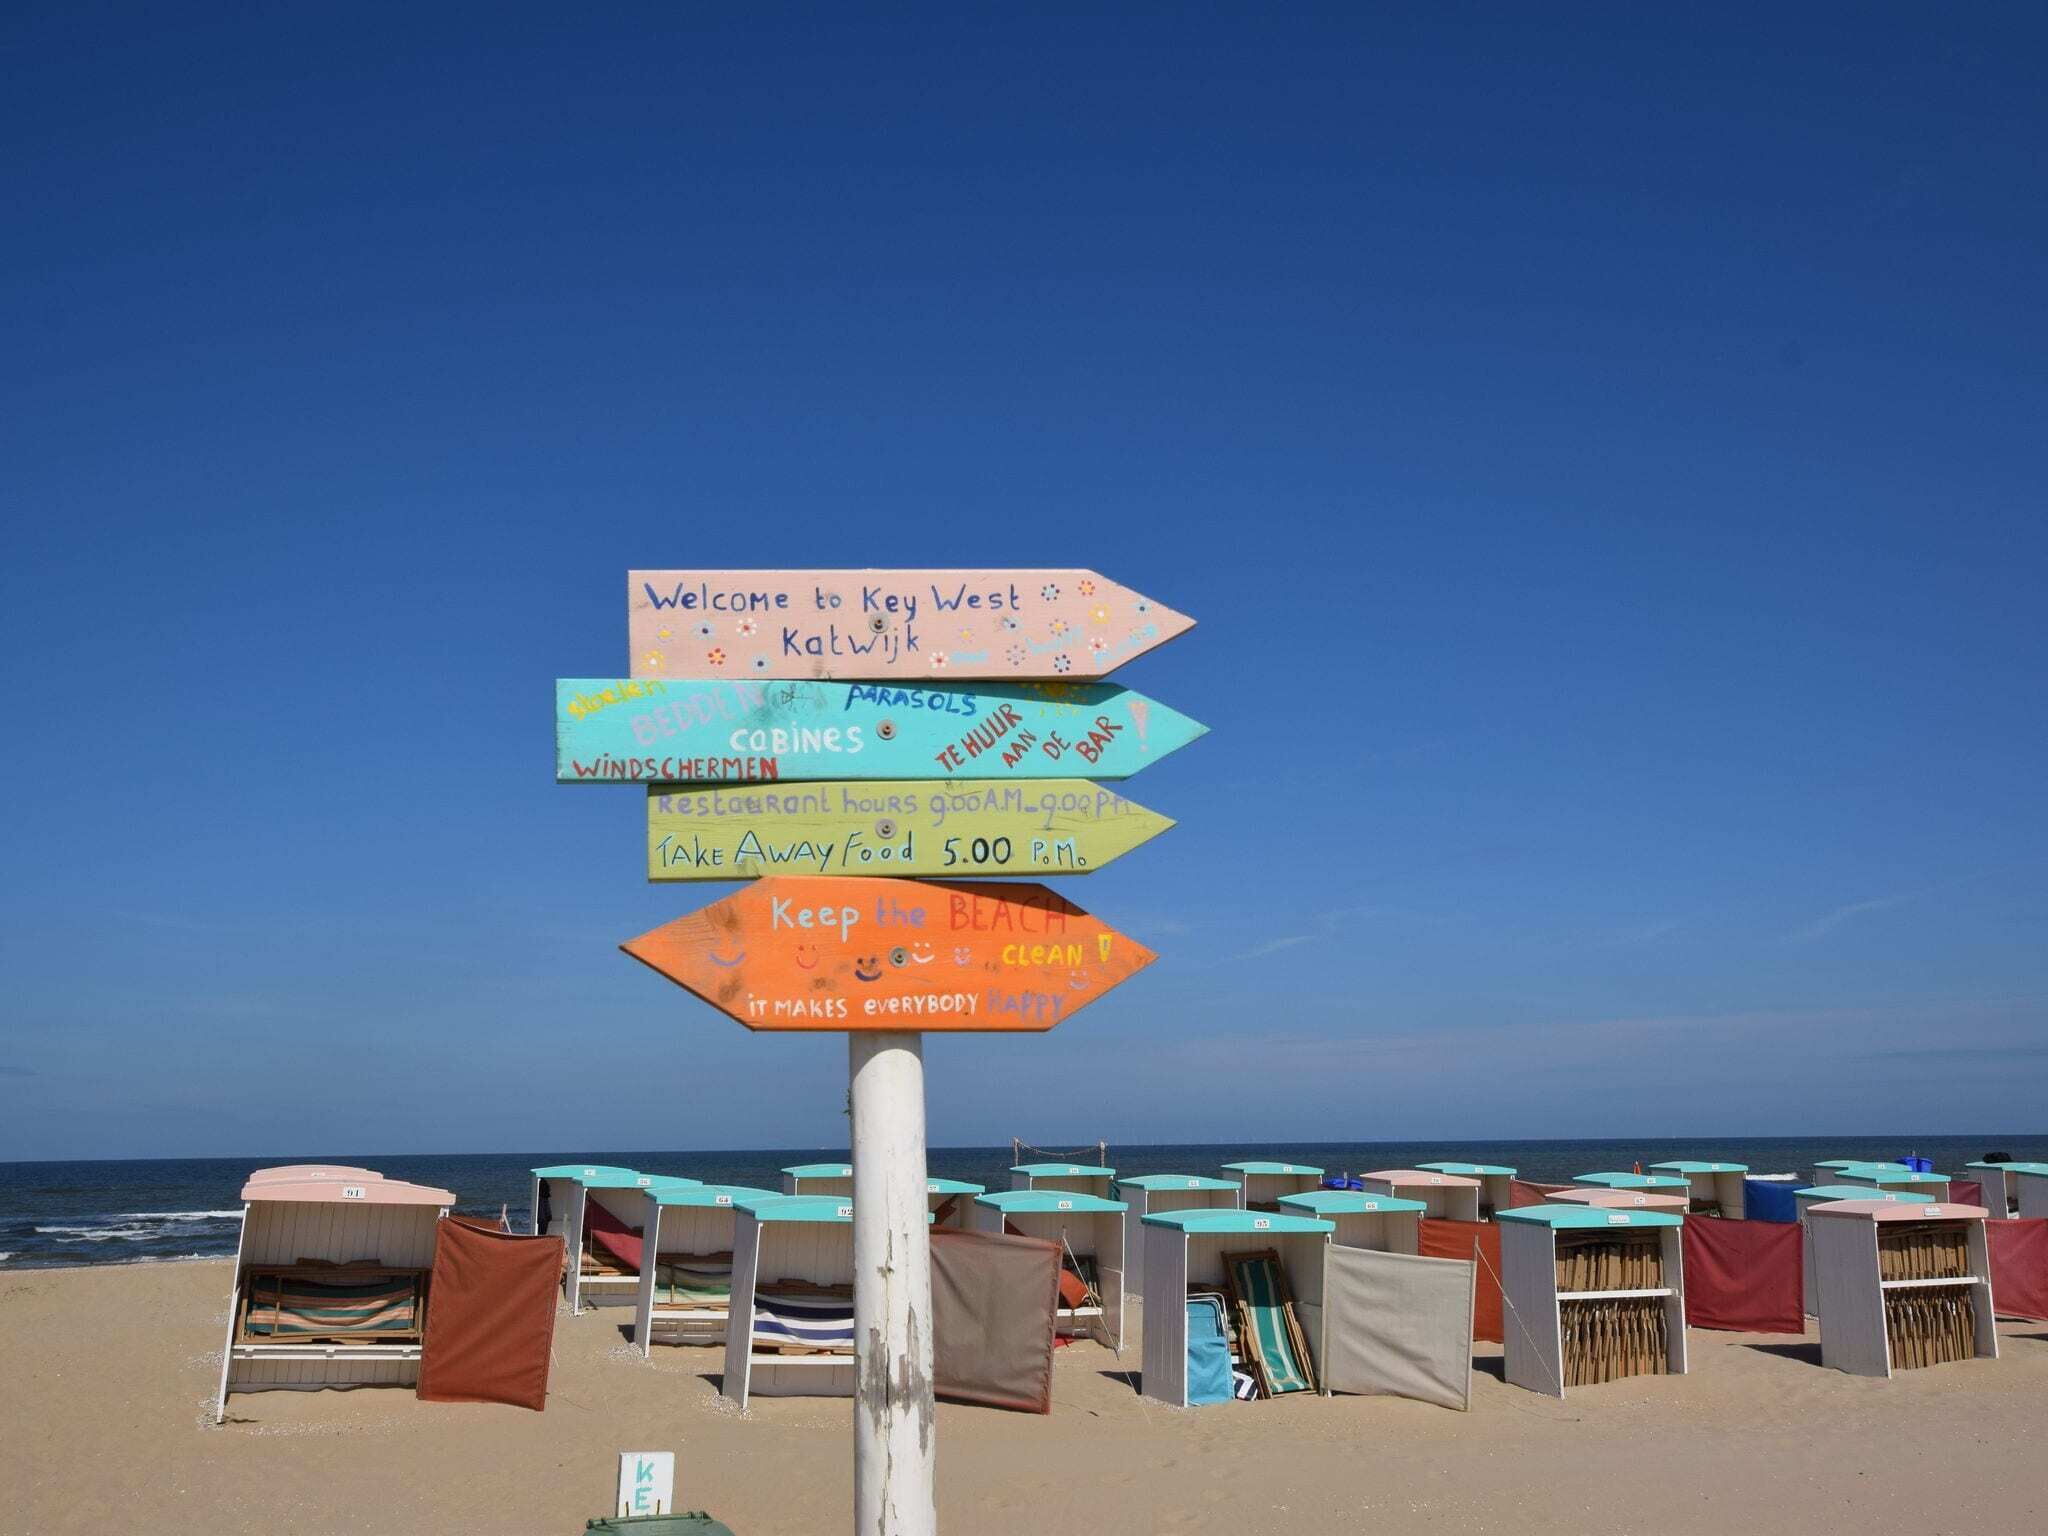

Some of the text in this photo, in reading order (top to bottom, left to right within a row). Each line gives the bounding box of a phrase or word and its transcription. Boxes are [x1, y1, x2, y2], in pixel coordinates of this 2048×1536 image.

[816, 587, 842, 610] to
[863, 586, 916, 622] Key
[931, 584, 1021, 611] West
[783, 624, 919, 664] Katwijk
[844, 684, 978, 717] PARASOLS
[934, 703, 1023, 772] TE HUUR
[1001, 727, 1072, 769] AAN DE
[1074, 715, 1123, 764] BAR
[842, 831, 913, 867] Food
[943, 837, 1012, 866] 5.00
[771, 894, 1067, 943] Keep the BEACH
[775, 998, 848, 1018] MAKES
